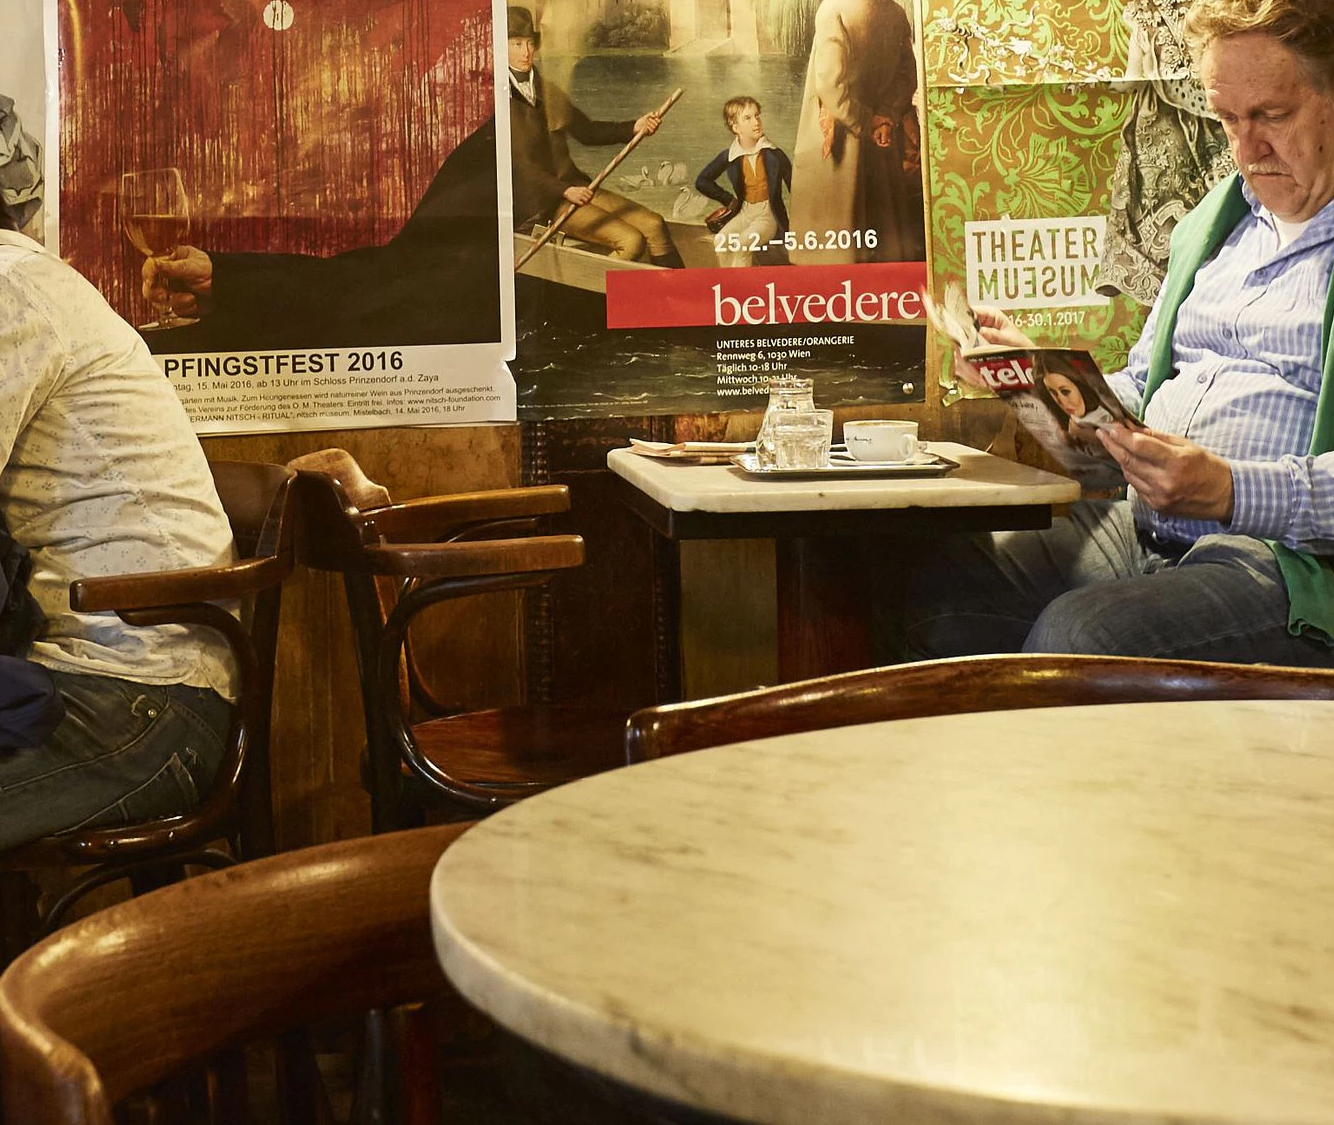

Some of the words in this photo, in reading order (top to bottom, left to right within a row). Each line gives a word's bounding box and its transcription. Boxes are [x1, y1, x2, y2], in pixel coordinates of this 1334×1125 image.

[972, 227, 1099, 263] THEATER
[712, 280, 921, 326] belvedere
[717, 337, 755, 349] UNTERES
[164, 353, 340, 377] PFINGSTFEST
[347, 350, 403, 372] 2016
[717, 351, 755, 362] Rennweg
[789, 349, 811, 359] Wien
[717, 363, 747, 374] Täglich
[771, 361, 788, 370] Uhr
[230, 380, 253, 389] 2016,
[283, 378, 298, 387] Uhr
[313, 376, 347, 386] Schloss
[348, 375, 398, 385] Prinzendorf
[418, 373, 439, 383] Zaya
